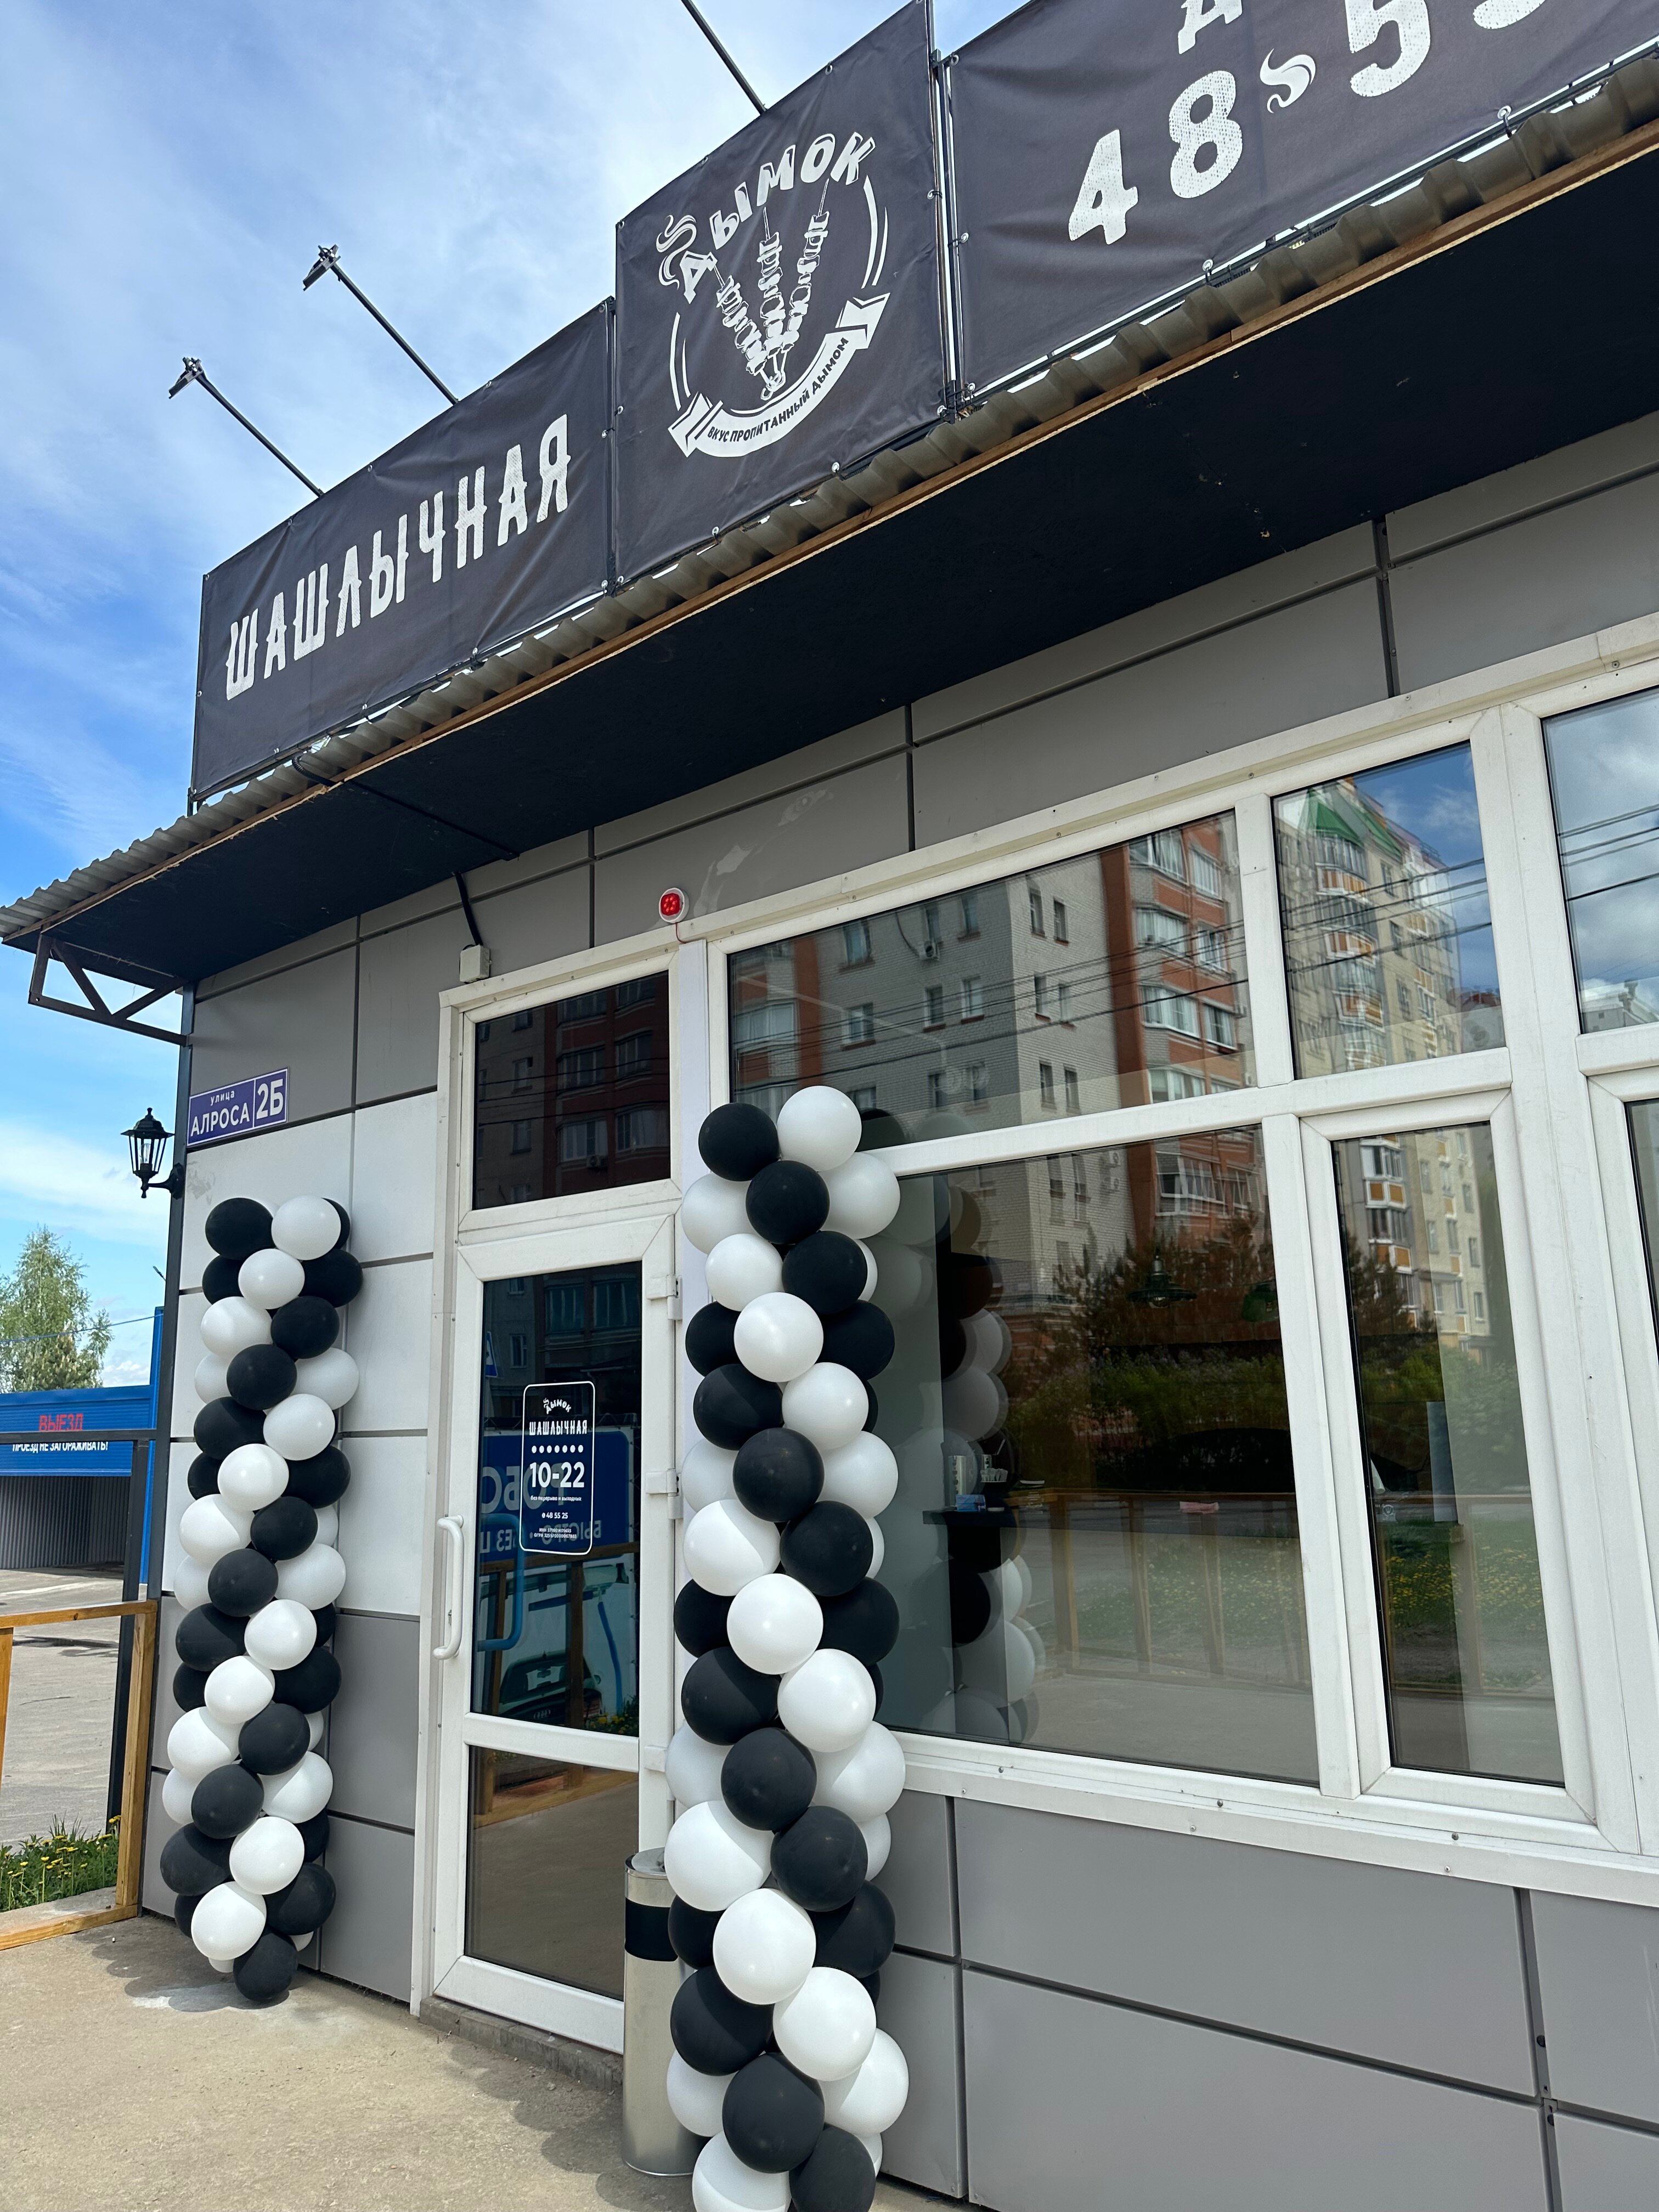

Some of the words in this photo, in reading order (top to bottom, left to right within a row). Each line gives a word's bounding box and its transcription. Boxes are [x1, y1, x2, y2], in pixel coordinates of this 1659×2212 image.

[1068, 70, 1243, 245] 48
[1346, 0, 1539, 97] 5
[656, 132, 876, 304] ДЫМОК
[707, 426, 730, 443] ВКУС
[730, 387, 810, 442] ПРОПИТАННЫЙ
[812, 337, 849, 395] ДЫМОМ
[225, 414, 571, 701] ШАШЛЫЧНАЯ
[190, 1102, 250, 1137] АЛРОСА
[256, 1078, 284, 1120] 2Б
[210, 1090, 235, 1107] улица
[39, 1413, 83, 1431] ВЫЕЗД
[529, 1419, 588, 1436] ШАШЛЫЧНАЯ
[529, 1462, 585, 1488] 10-22
